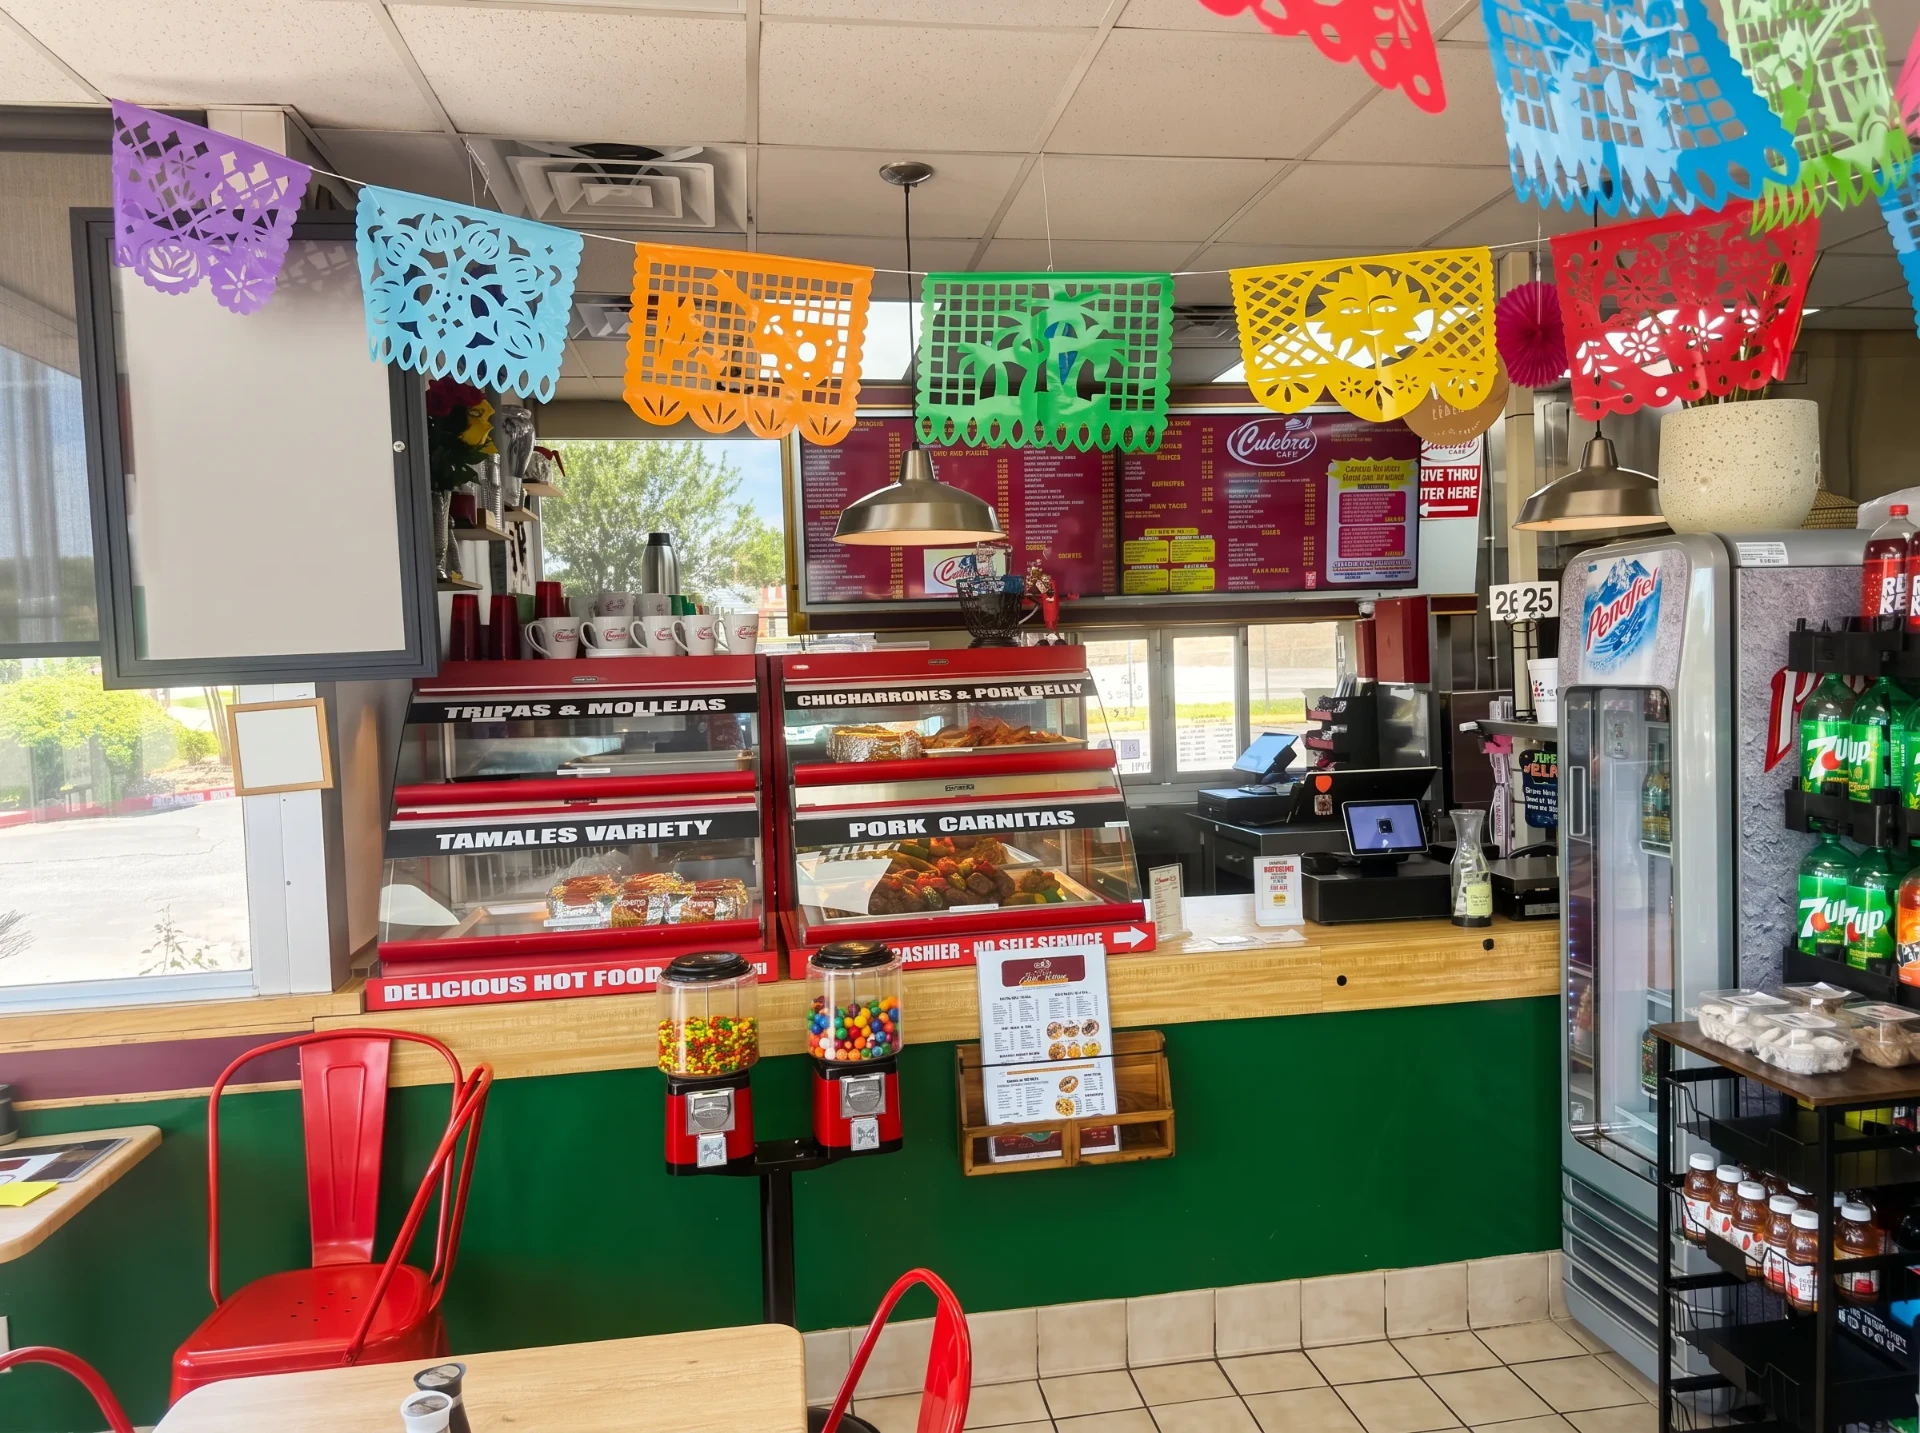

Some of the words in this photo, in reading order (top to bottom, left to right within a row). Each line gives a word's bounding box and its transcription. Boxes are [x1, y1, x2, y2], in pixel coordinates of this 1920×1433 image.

[1237, 425, 1312, 456] Culebra
[1420, 469, 1444, 482] RIVE
[1446, 468, 1477, 481] THRU
[1447, 486, 1478, 499] HERE
[1523, 587, 1553, 613] 25
[797, 690, 952, 707] CHICHARRONES
[957, 688, 971, 700] &
[974, 685, 1026, 700] PORK
[1030, 683, 1083, 697] BELLY
[444, 704, 551, 720] TRIPAS
[558, 704, 581, 716] &
[587, 698, 727, 716] MOLLEJAS
[436, 826, 578, 850] TAMALES
[585, 819, 713, 842] VARIETY
[849, 819, 928, 838] PORK
[939, 809, 1076, 832] CARNITAS
[383, 975, 527, 1003] DELICIOUS
[533, 971, 588, 992] HOT
[594, 966, 658, 987] FOOD
